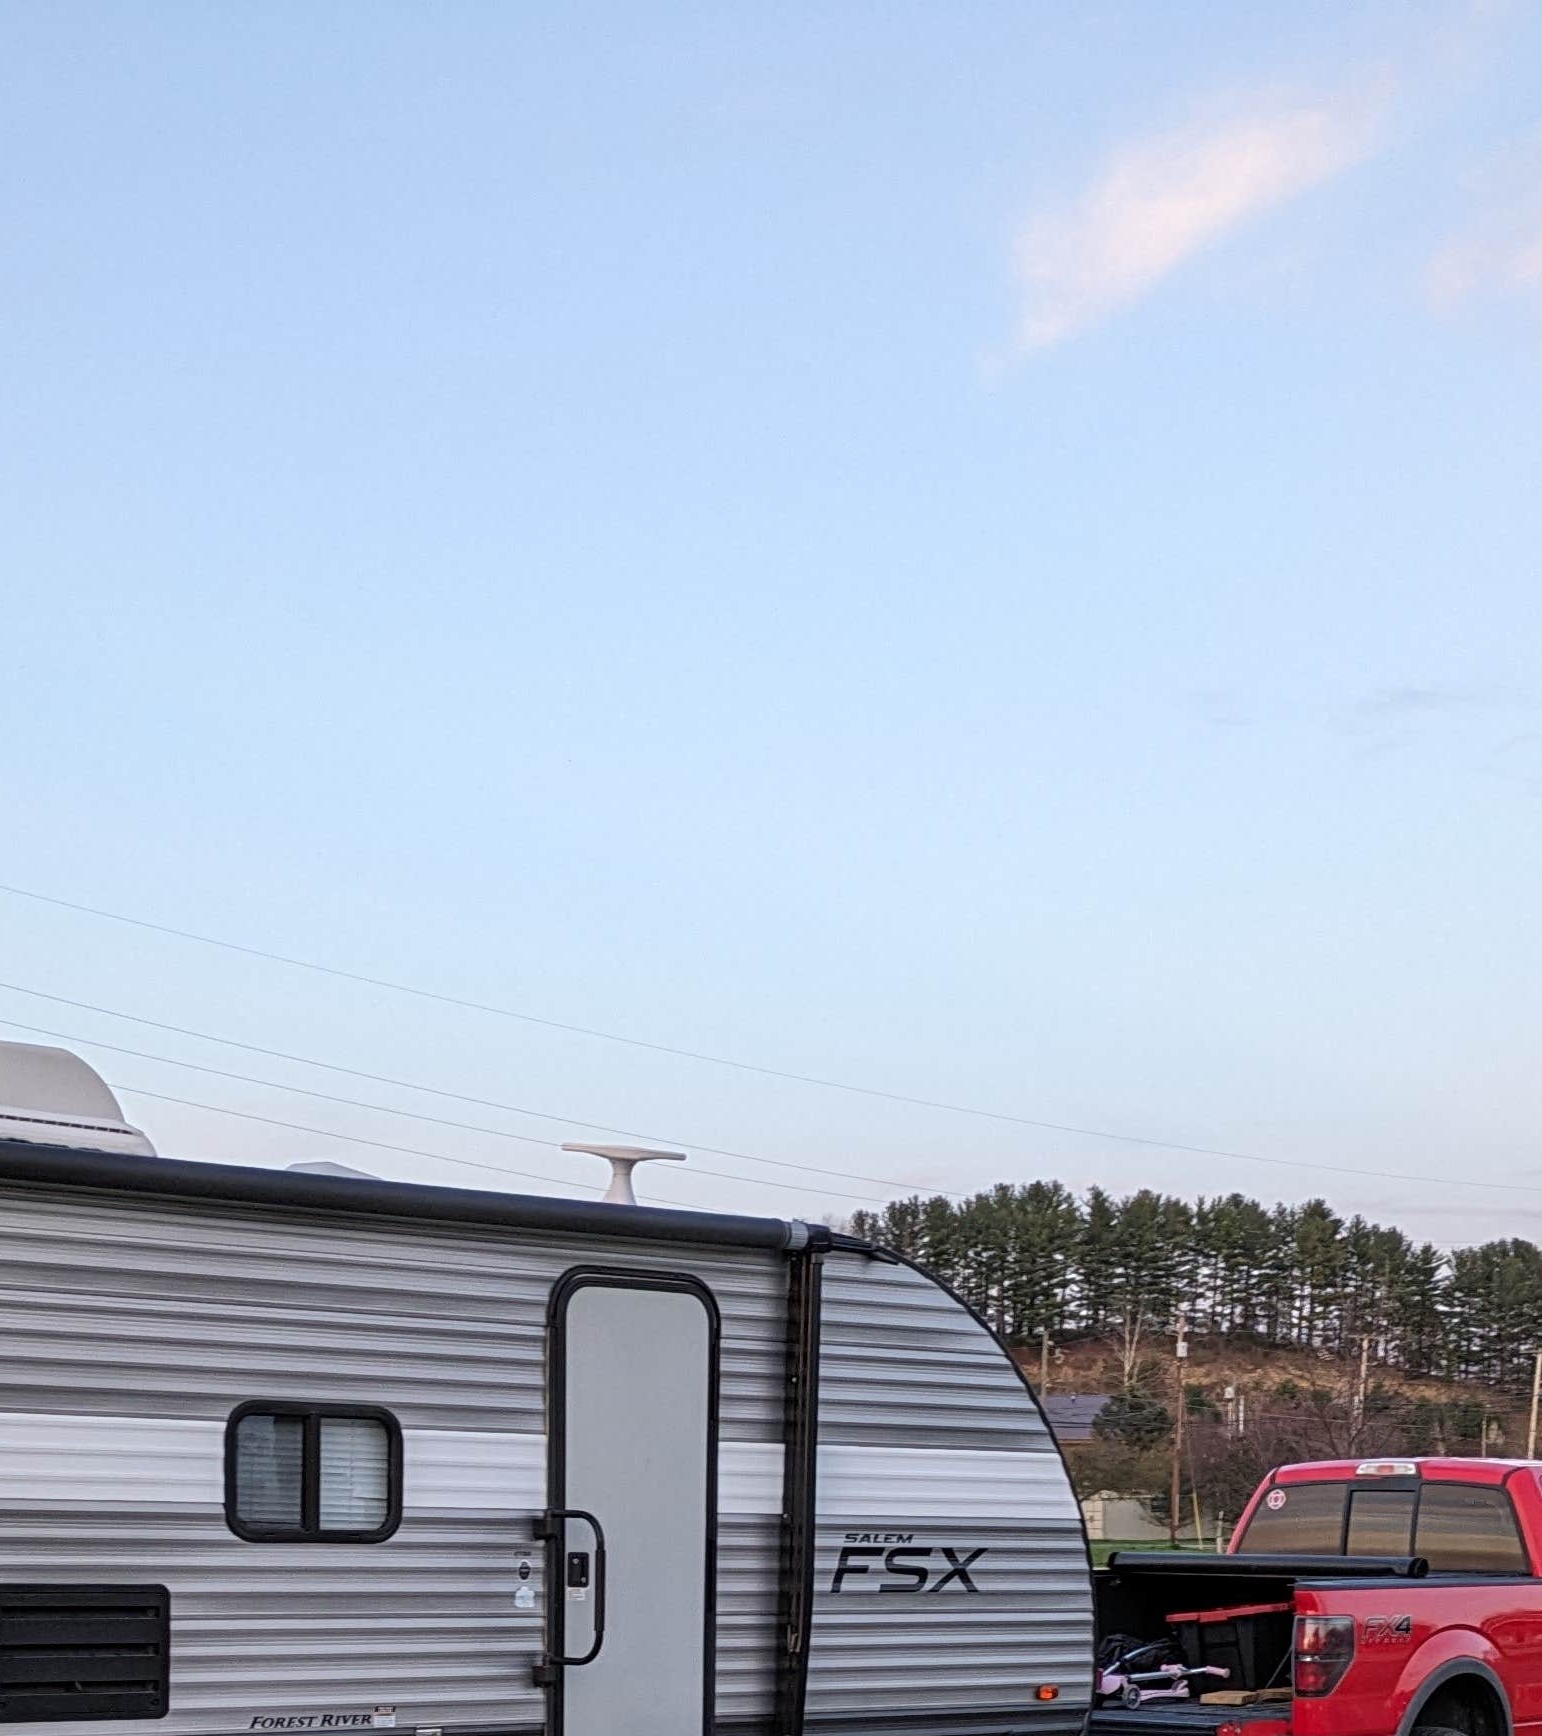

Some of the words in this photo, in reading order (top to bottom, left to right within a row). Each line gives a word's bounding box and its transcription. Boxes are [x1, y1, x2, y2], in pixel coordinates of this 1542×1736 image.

[843, 1533, 914, 1544] SALEM
[830, 1546, 989, 1593] FSX
[1364, 1615, 1411, 1637] FX4
[249, 1715, 318, 1729] FOREST
[321, 1713, 371, 1727] RIVER
